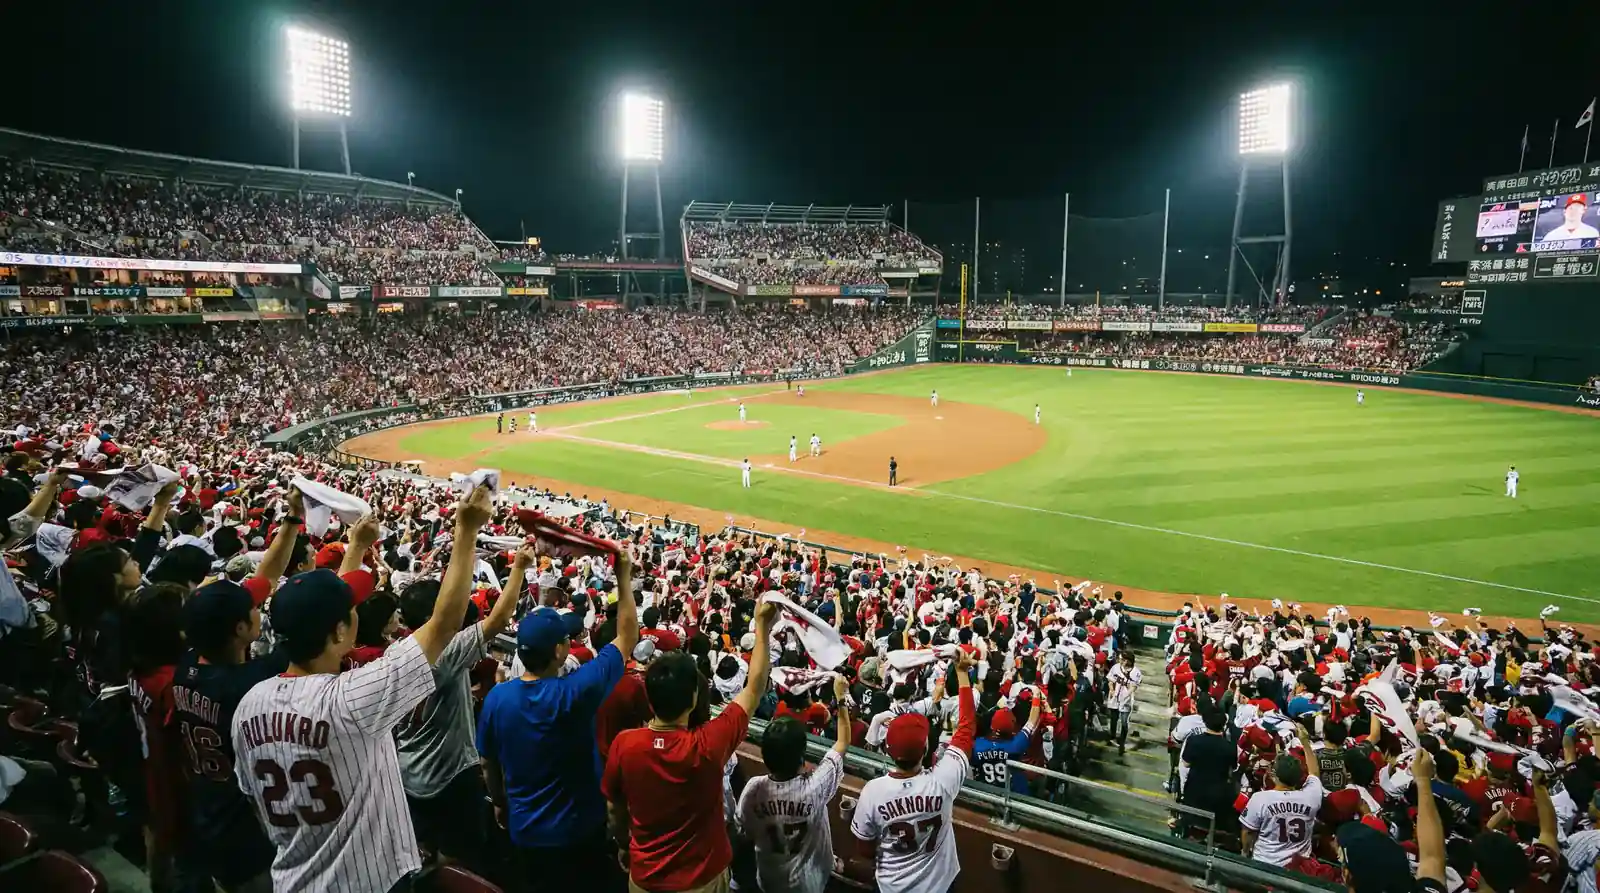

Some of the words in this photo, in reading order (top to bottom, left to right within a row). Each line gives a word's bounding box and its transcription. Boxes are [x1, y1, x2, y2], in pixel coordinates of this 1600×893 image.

[982, 762, 1007, 783] 99
[254, 758, 344, 827] 23
[1276, 818, 1306, 843] 13
